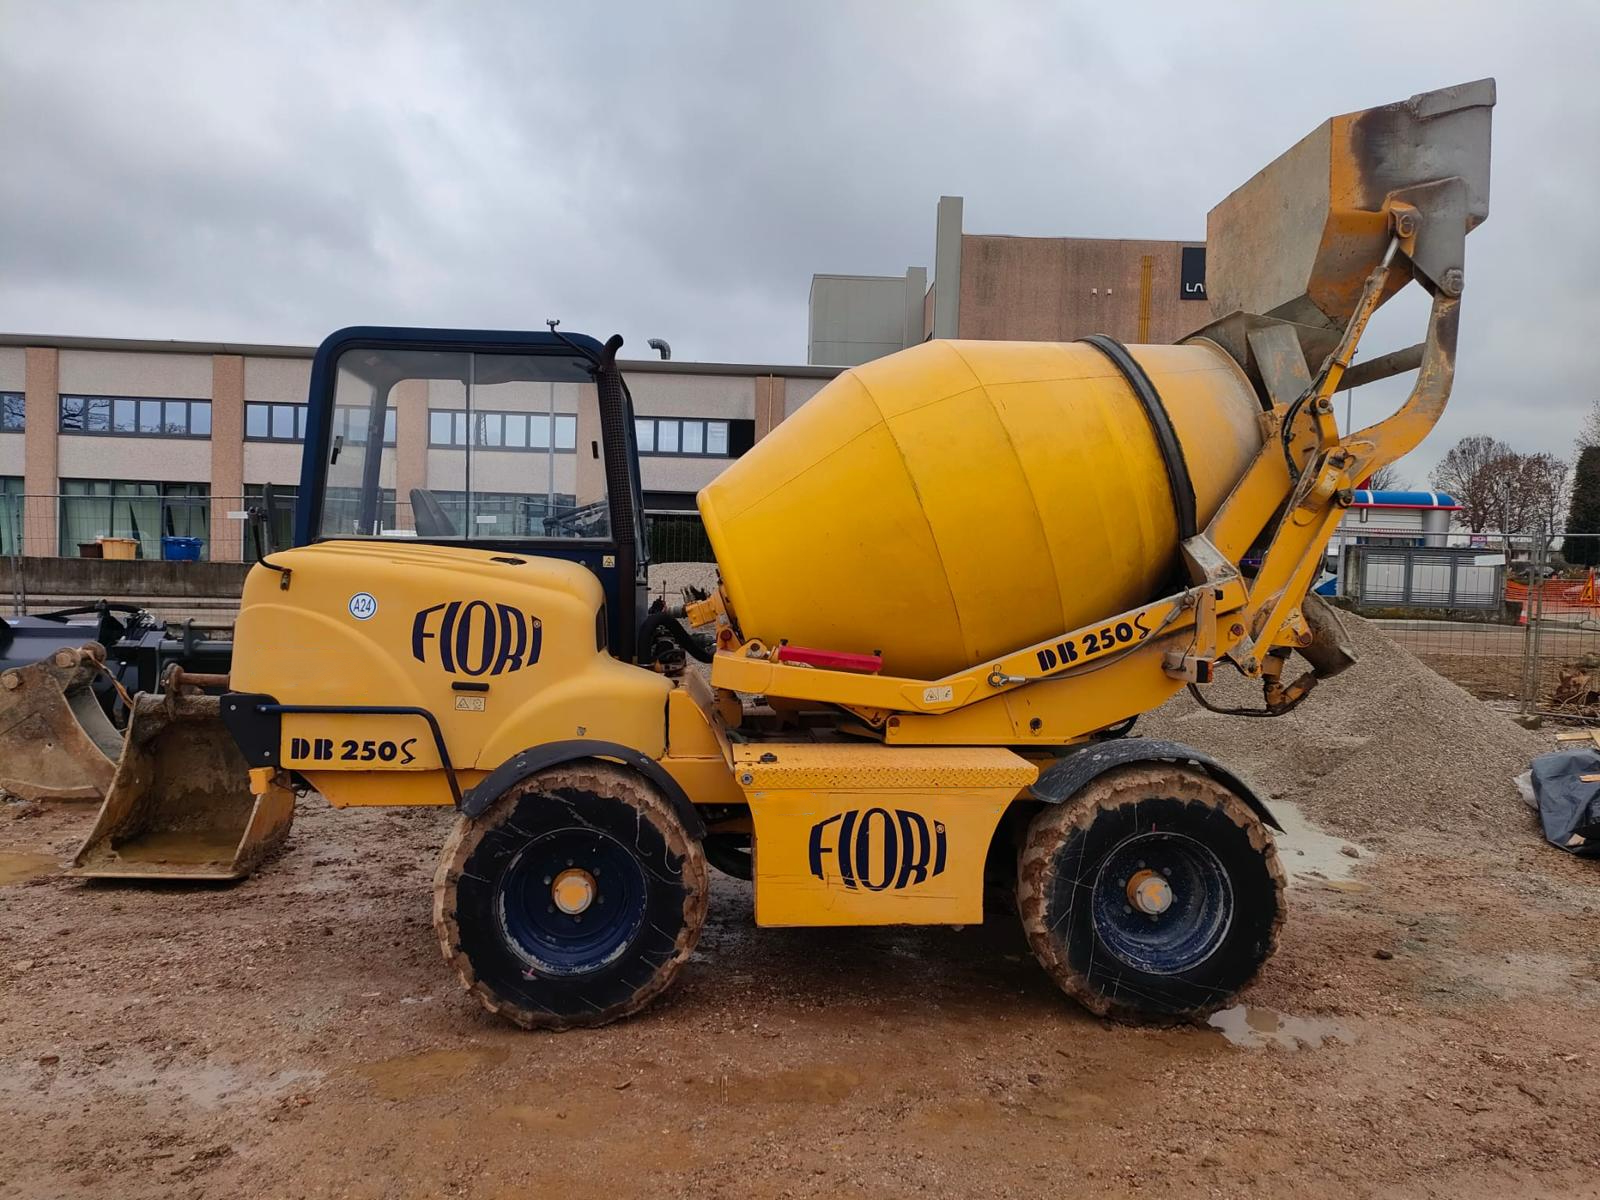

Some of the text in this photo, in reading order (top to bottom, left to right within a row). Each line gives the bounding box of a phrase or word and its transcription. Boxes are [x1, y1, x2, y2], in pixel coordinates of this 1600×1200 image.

[353, 598, 372, 613] A24
[411, 600, 543, 676] FIORI
[1036, 640, 1078, 672] DB
[291, 738, 333, 760] DB
[808, 807, 947, 891] FIORI
